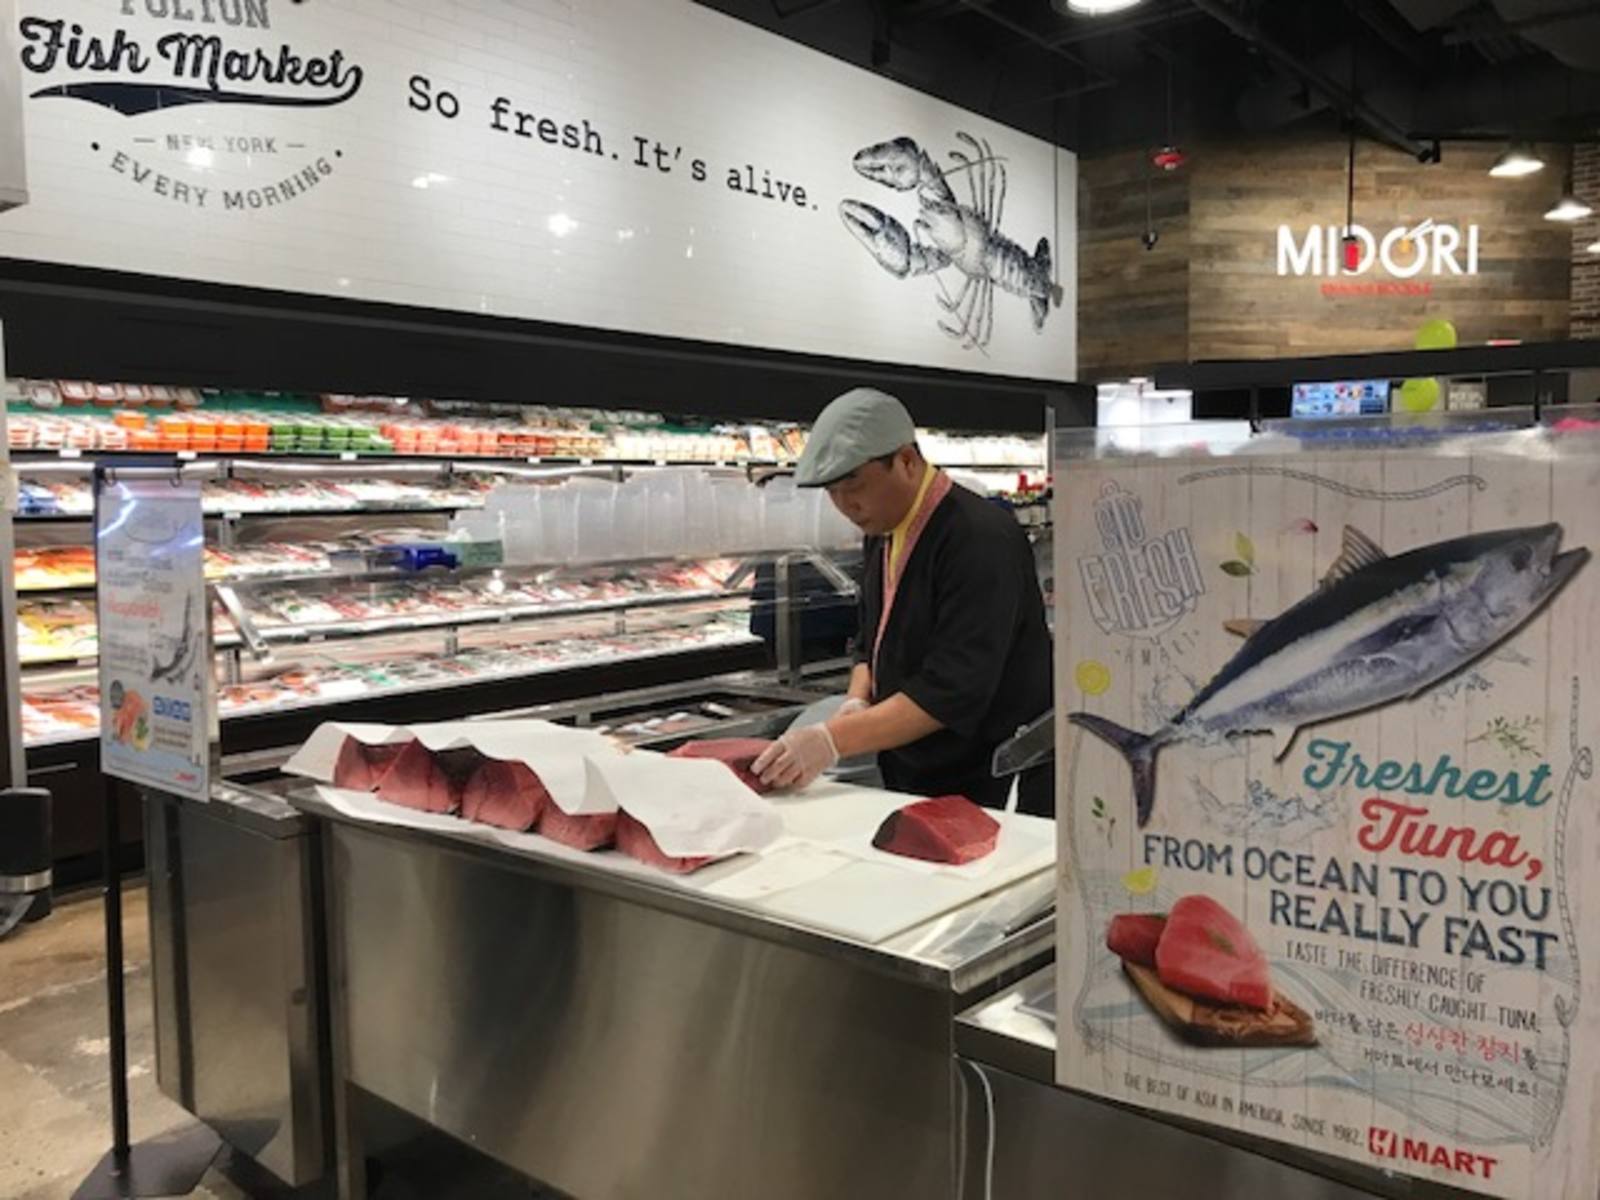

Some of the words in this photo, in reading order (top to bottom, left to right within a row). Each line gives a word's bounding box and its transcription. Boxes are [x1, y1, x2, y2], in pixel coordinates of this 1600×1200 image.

[19, 16, 150, 74] Fish
[156, 32, 363, 92] Market
[222, 136, 278, 153] YORK
[408, 75, 460, 118] So
[490, 97, 620, 160] fresh.
[633, 135, 707, 182] It's
[726, 165, 819, 211] alive.
[110, 150, 208, 207] EVERY
[222, 156, 333, 210] MORNING
[1276, 220, 1479, 278] MIDORI
[1303, 739, 1554, 807] Freshest
[1357, 798, 1544, 881] Tuna,
[1143, 835, 1233, 876] FROM
[1243, 847, 1380, 899] OCEAN
[1390, 867, 1446, 906] TO
[1458, 877, 1551, 922] YOU
[1269, 889, 1429, 949] REALLY
[1444, 915, 1559, 971] FAST
[1286, 940, 1327, 966] TASTE
[1338, 949, 1361, 973] THE
[1371, 954, 1458, 989] DIFFERENCE
[1466, 972, 1486, 993] OF
[1360, 979, 1420, 1010] FRESHLY
[1428, 993, 1487, 1023] CAUGHT
[1146, 1077, 1173, 1099] BEST
[1177, 1084, 1191, 1101] OF
[1222, 1094, 1234, 1113] IN
[1402, 1137, 1498, 1179] MART
